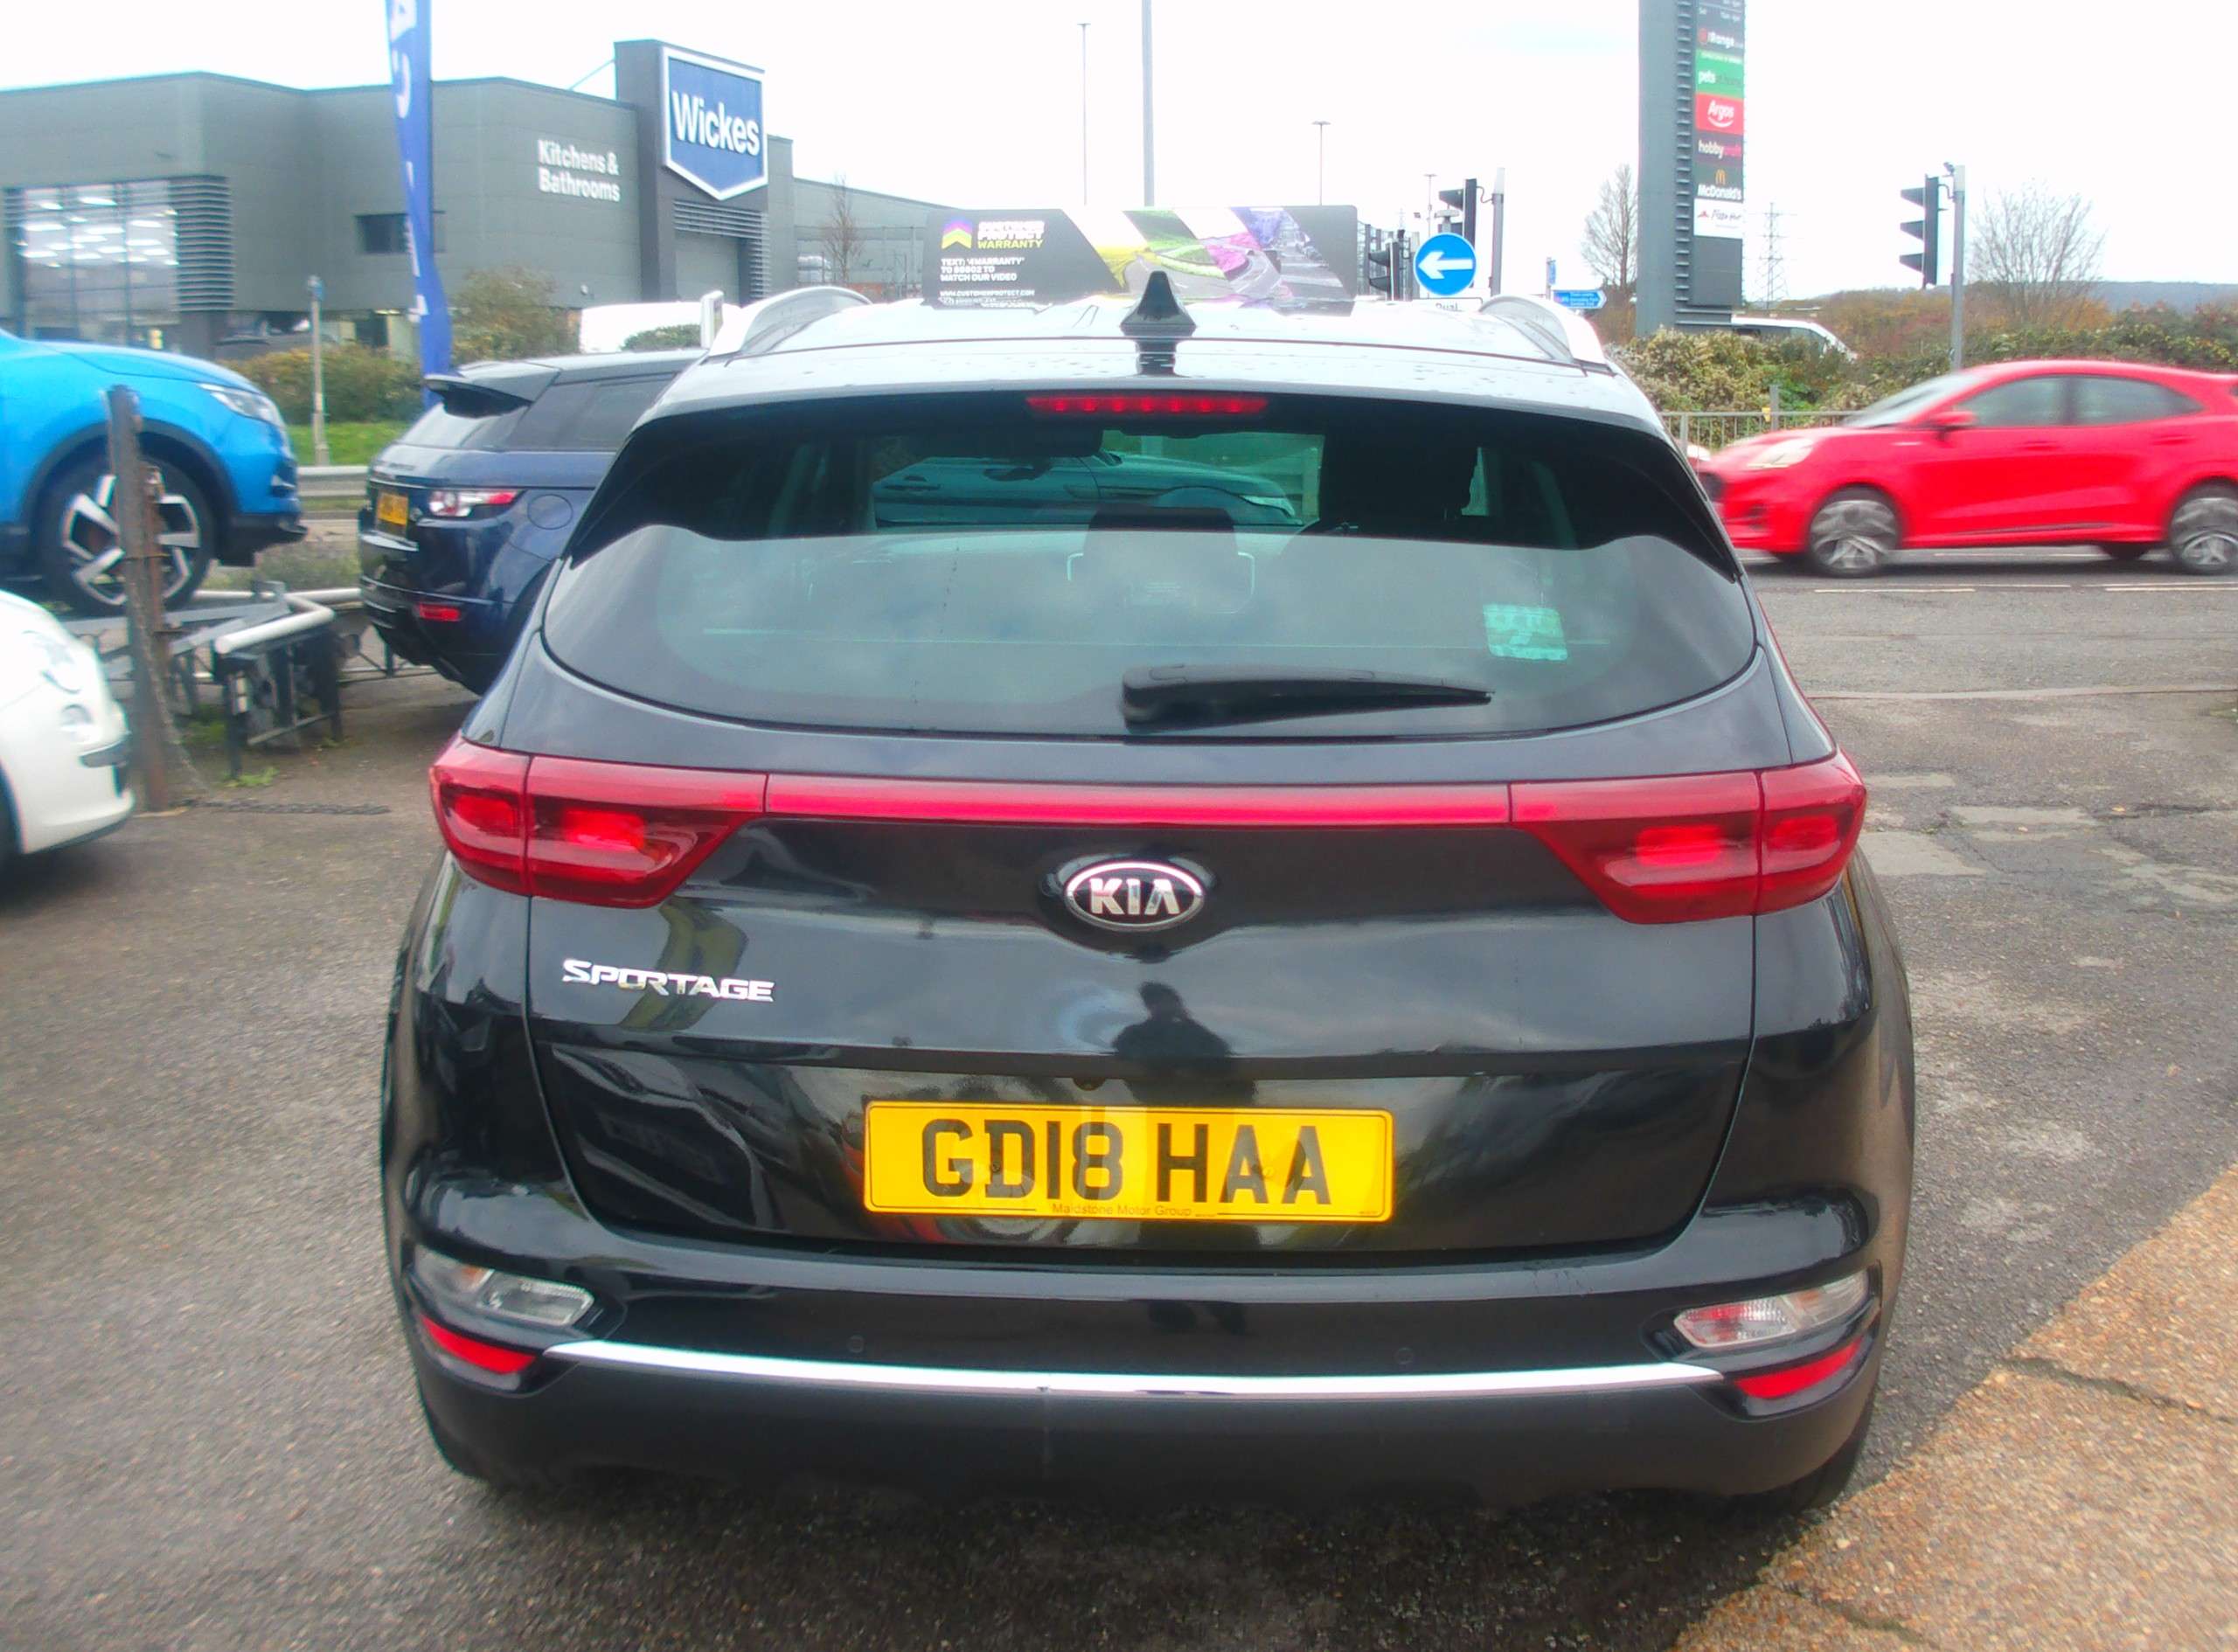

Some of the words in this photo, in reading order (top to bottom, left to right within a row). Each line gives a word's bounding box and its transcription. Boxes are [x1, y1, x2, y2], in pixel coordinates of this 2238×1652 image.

[671, 91, 760, 156] Wickes
[1707, 100, 1734, 121] Argos
[538, 139, 606, 174] Kitchens
[608, 152, 619, 175] &
[538, 167, 621, 202] Bathrooms
[1697, 184, 1742, 200] McDonald's
[978, 239, 1043, 249] WARRANTY
[971, 273, 990, 281] OUR
[990, 272, 1018, 281] VIDEO
[983, 265, 996, 274] TO
[1089, 878, 1180, 915] KIA
[561, 958, 775, 1003] SPORTAGE
[921, 1118, 1124, 1201] GD18
[1157, 1122, 1331, 1205] HAA
[1052, 1203, 1113, 1215] Maidstone
[1117, 1204, 1150, 1216] Motor
[1154, 1204, 1192, 1218] Group
